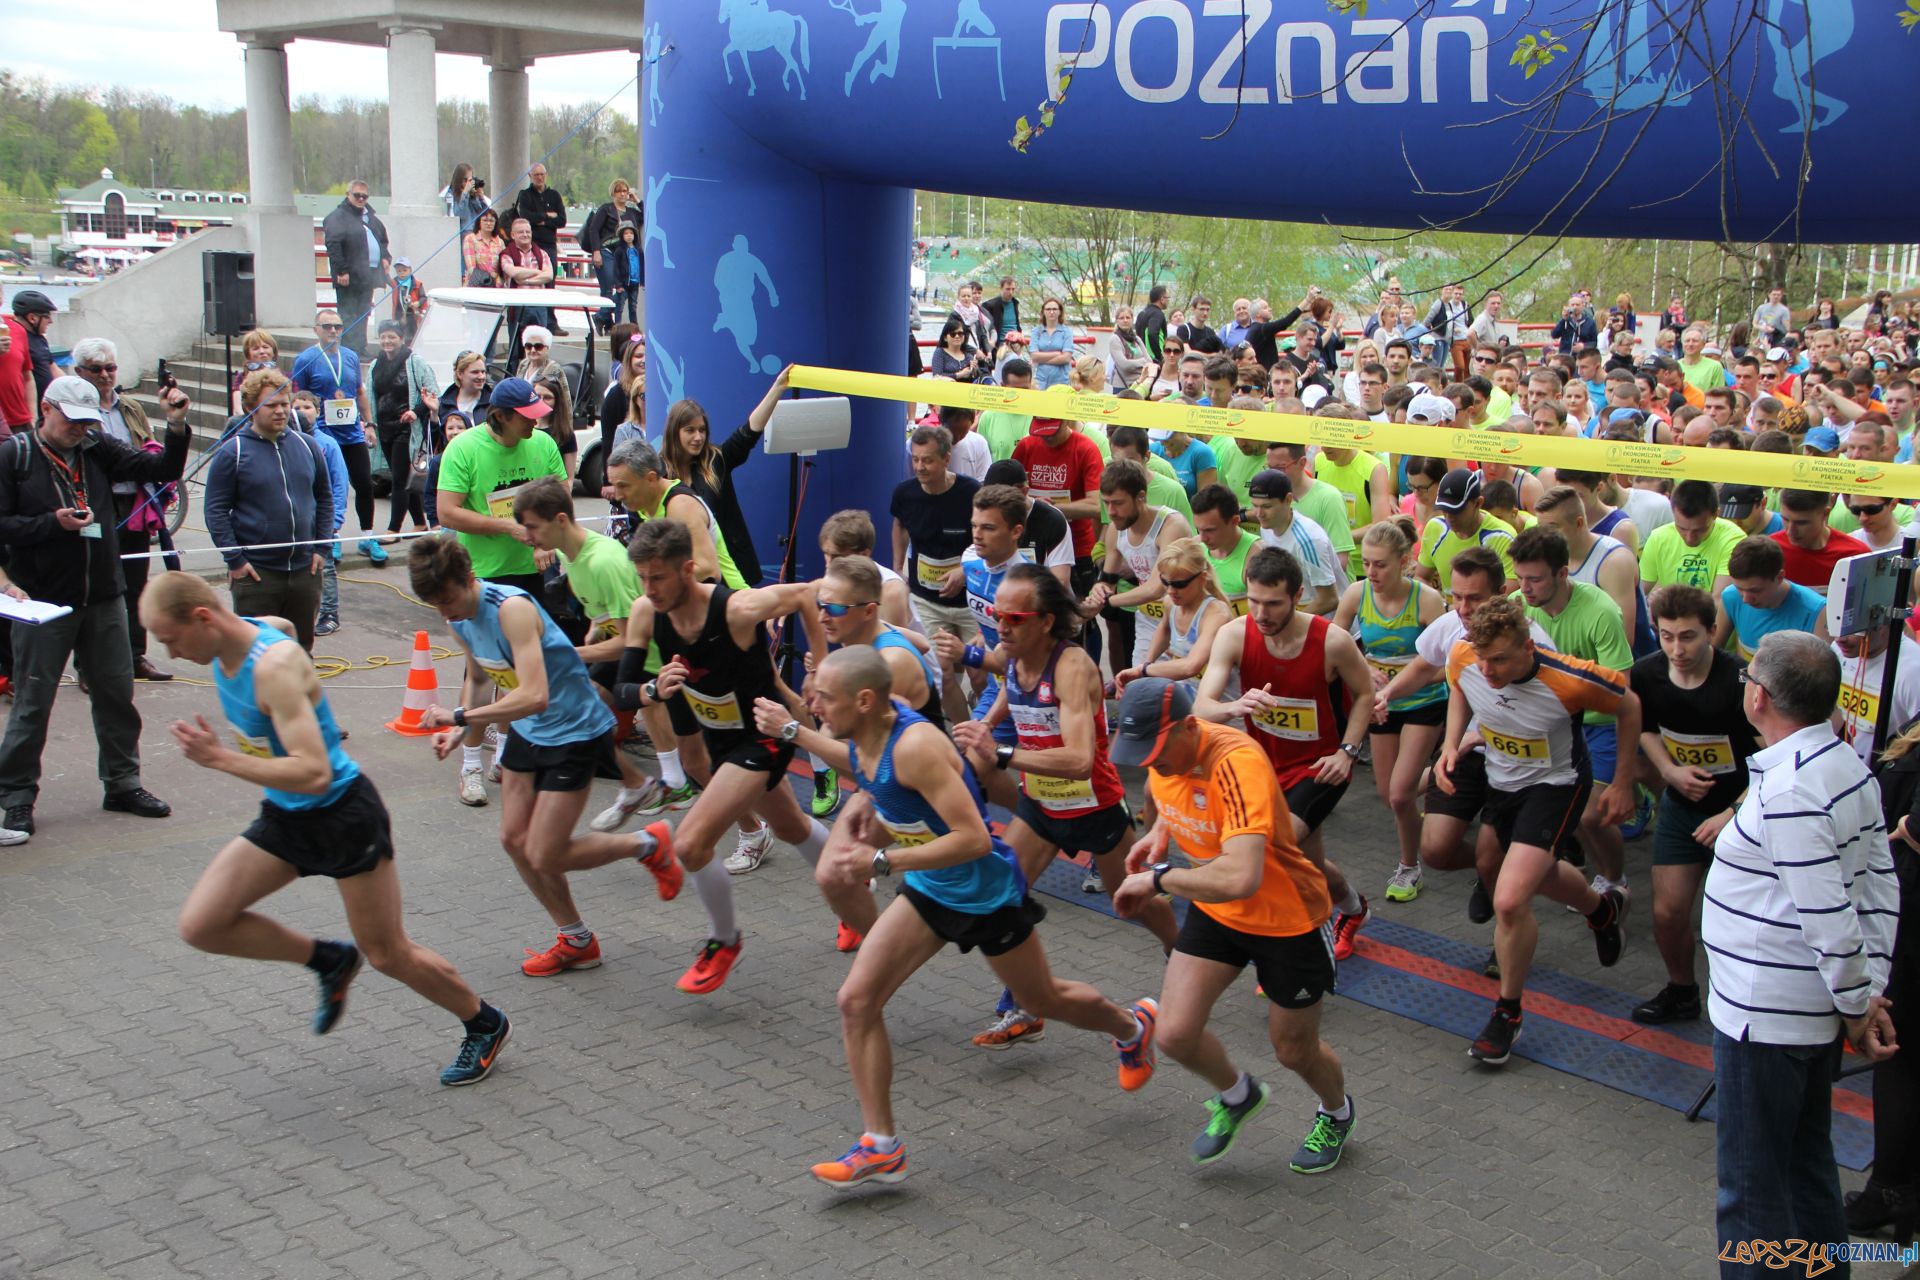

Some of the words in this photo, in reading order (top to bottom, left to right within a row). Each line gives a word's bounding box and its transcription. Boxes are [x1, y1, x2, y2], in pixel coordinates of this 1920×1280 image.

[336, 408, 350, 419] 67
[1814, 460, 1856, 468] VOLKSWAGEN
[1811, 466, 1856, 475] EKONOMICZNA
[1030, 471, 1067, 483] SZPIKU
[1841, 691, 1869, 717] 529
[1492, 736, 1531, 757] 661
[1676, 747, 1718, 765] 636
